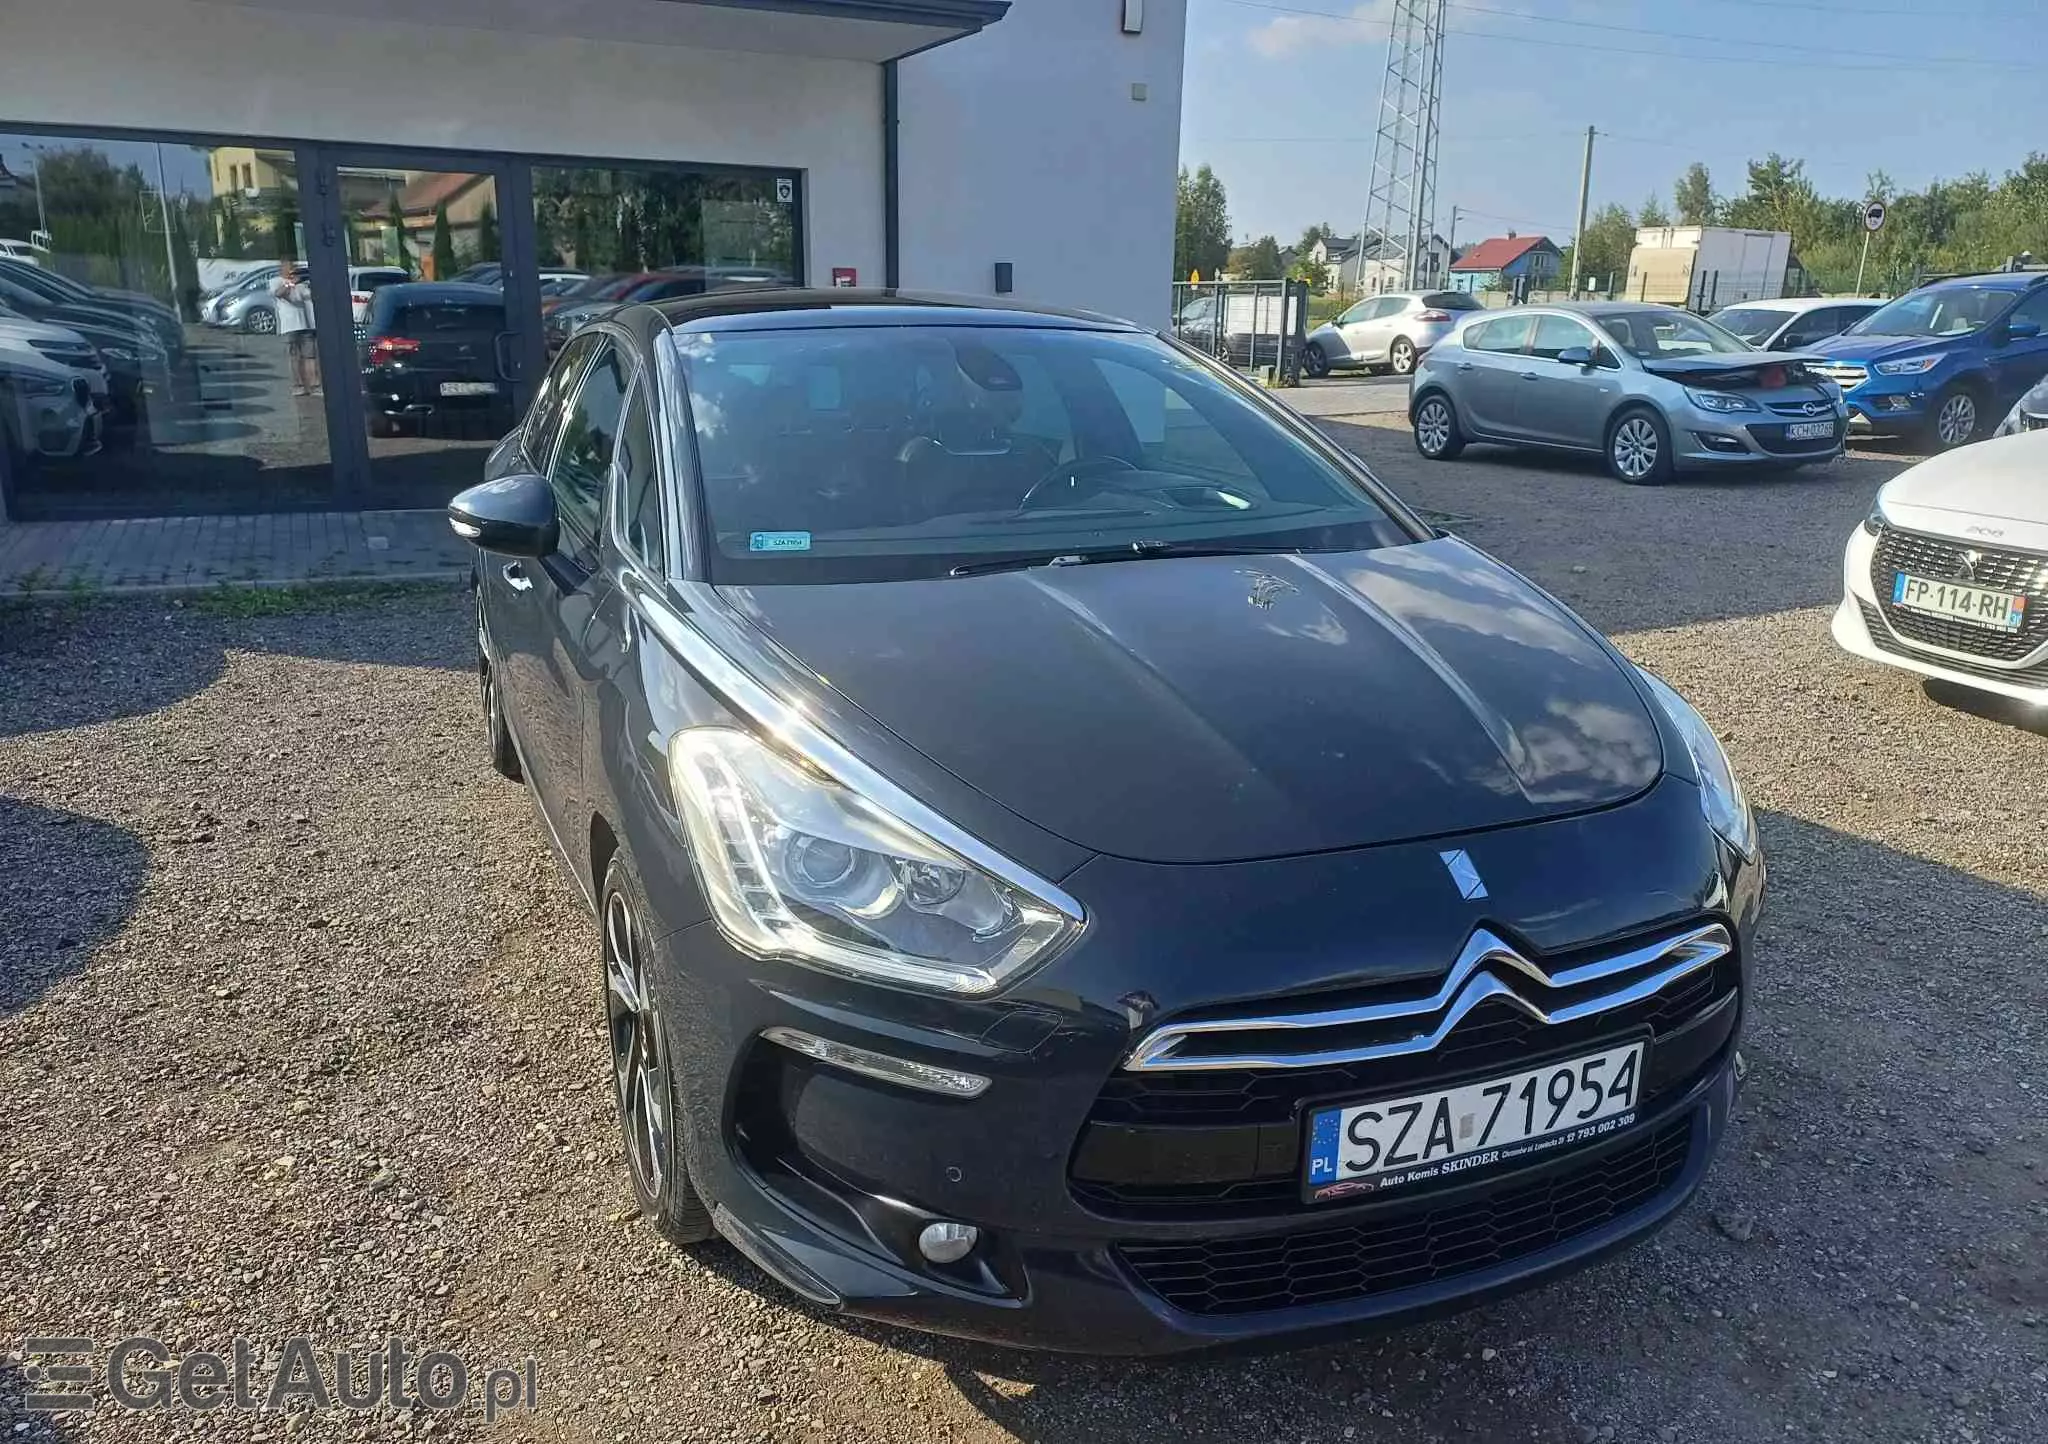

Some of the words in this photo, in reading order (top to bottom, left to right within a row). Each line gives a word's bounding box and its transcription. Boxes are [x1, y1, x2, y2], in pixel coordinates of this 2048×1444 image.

[1345, 1097, 1455, 1171] SZA
[1477, 1049, 1638, 1147] 71954
[1312, 1157, 1332, 1175] PL
[1380, 1175, 1405, 1188] Auto
[1407, 1167, 1439, 1182] Komis
[1441, 1151, 1500, 1174] SKINDER
[1577, 1126, 1596, 1140] 793
[1598, 1120, 1616, 1134] 002
